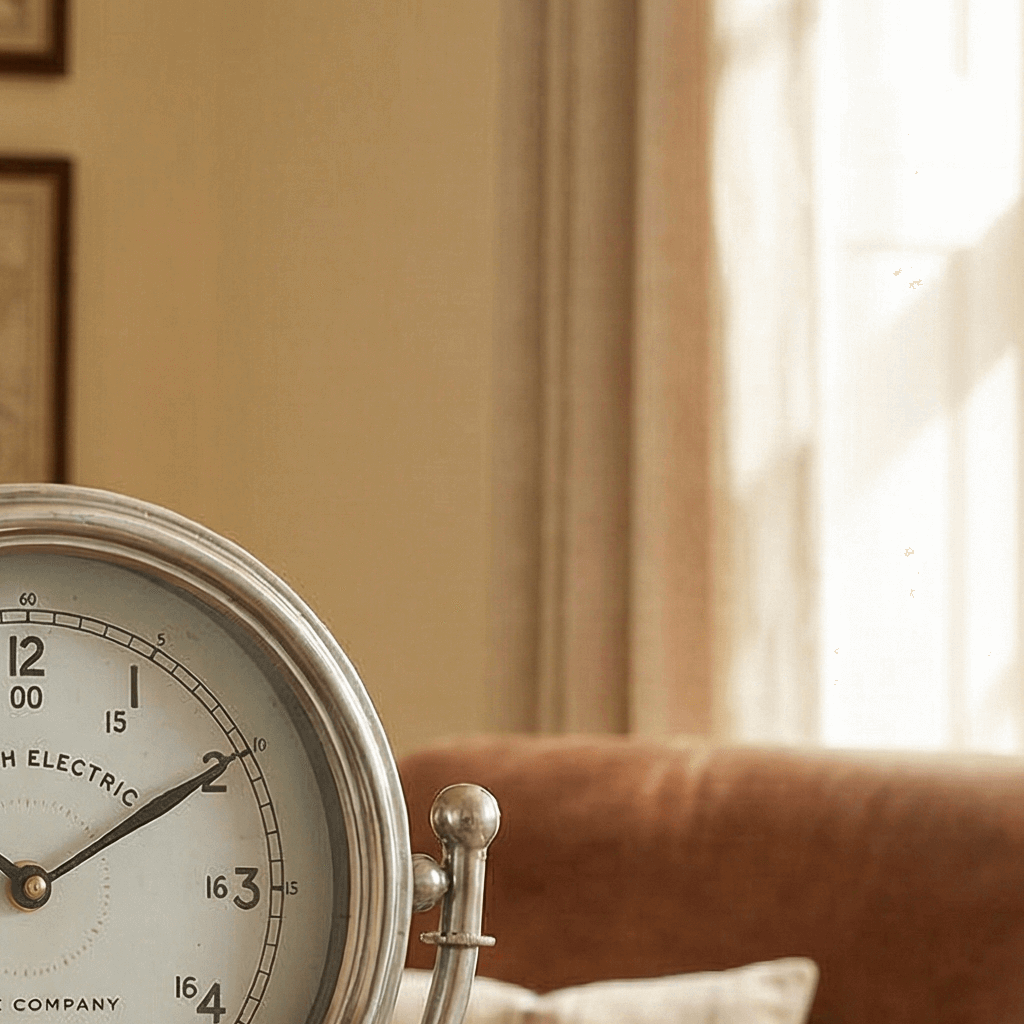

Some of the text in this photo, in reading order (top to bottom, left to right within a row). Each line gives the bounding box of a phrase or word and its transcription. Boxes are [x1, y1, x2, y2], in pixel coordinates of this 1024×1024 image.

[19, 592, 37, 606] 60
[157, 633, 166, 647] 5
[10, 636, 45, 676] 12
[11, 686, 42, 709] 00
[131, 665, 138, 708] 1
[106, 711, 126, 733] 15
[253, 737, 267, 752] 10
[27, 749, 139, 807] ELECTRIC
[202, 751, 227, 792] 2
[207, 875, 228, 898] 16
[233, 867, 260, 910] 3
[285, 881, 298, 895] 15
[176, 976, 197, 998] 16
[14, 998, 119, 1011] COMPANY
[196, 982, 226, 1024] 4
